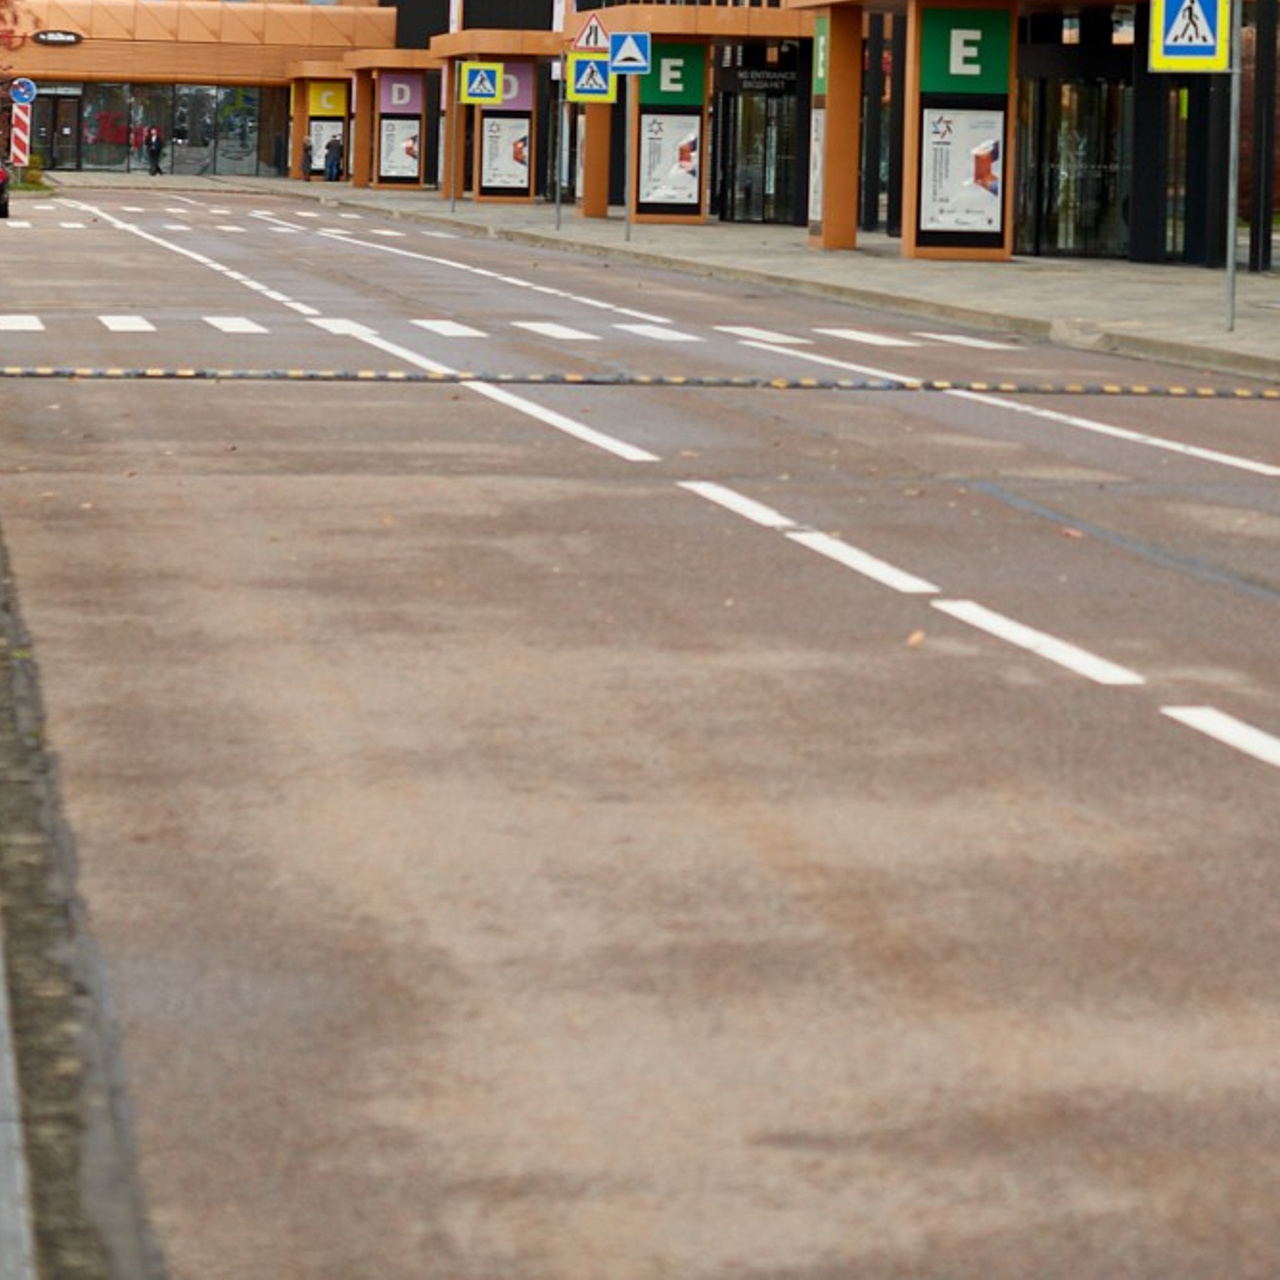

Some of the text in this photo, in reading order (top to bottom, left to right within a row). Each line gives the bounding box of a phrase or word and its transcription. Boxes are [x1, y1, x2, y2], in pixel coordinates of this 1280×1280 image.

[950, 28, 982, 75] E
[660, 58, 684, 92] E
[321, 90, 335, 110] C
[391, 83, 411, 106] D
